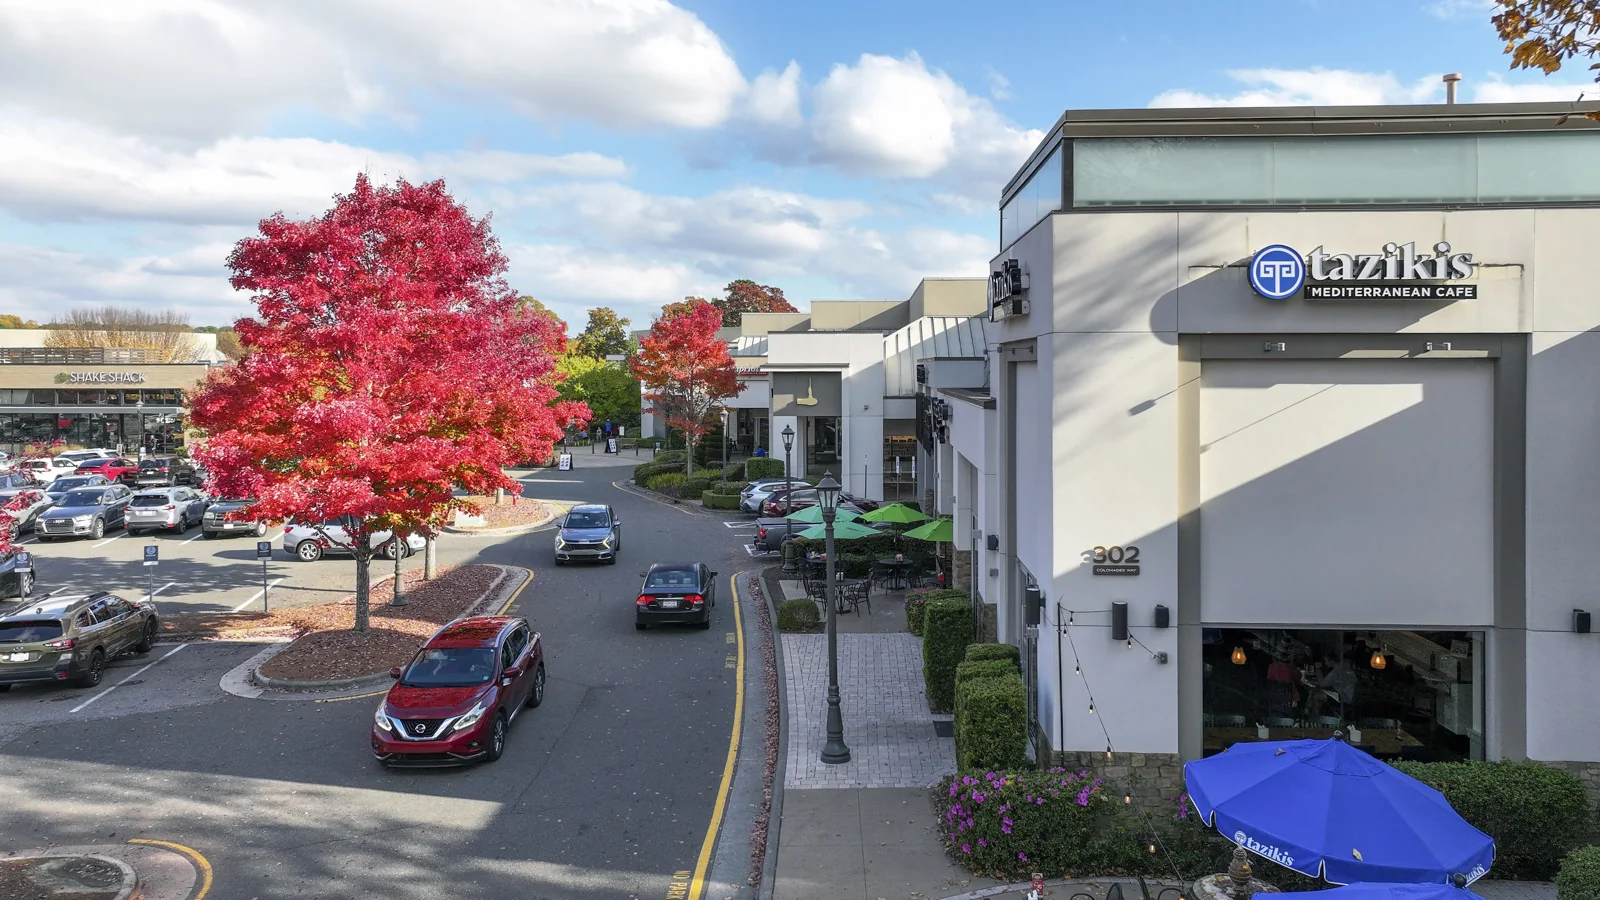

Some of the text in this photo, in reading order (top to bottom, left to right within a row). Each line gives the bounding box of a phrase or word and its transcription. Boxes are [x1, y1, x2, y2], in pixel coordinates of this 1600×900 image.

[1308, 241, 1474, 281] tazikis
[1312, 286, 1474, 298] MEDITERRANEAN CAFE
[70, 371, 146, 382] SHAKE SHACK
[1093, 545, 1140, 564] 302
[1247, 836, 1296, 867] tazikis
